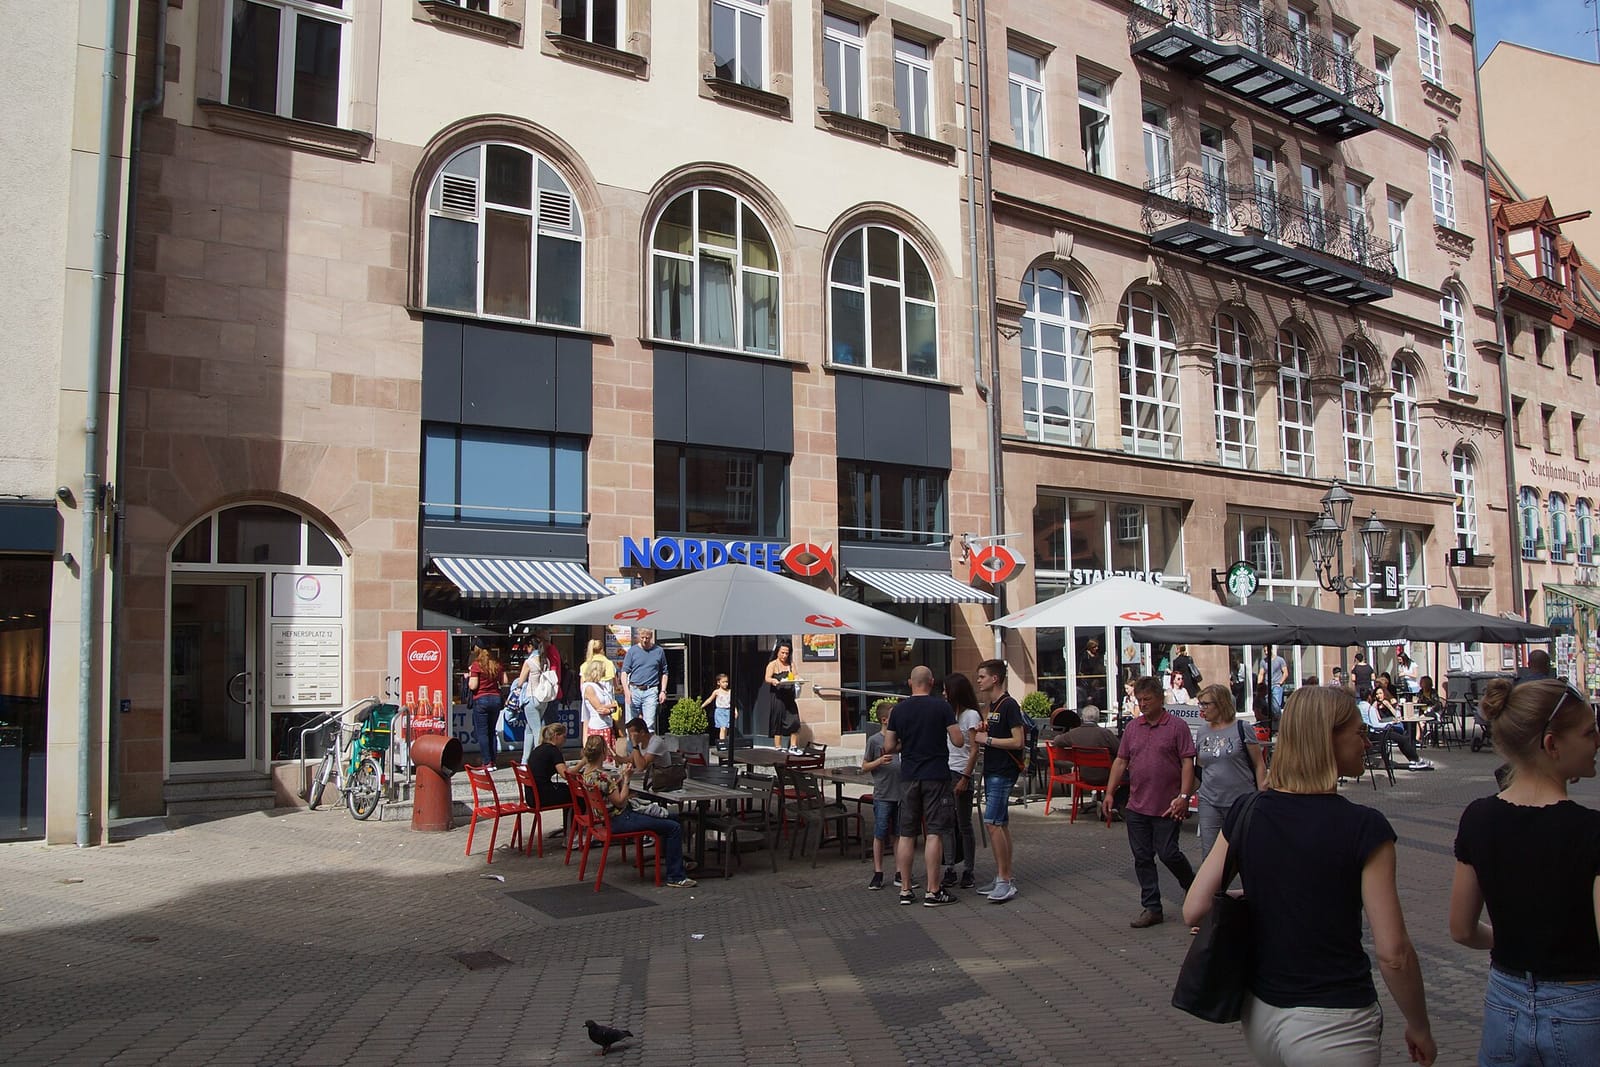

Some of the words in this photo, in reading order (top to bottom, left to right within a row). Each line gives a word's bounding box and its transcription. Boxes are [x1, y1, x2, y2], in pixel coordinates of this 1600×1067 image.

[1529, 457, 1580, 489] Buchhandlung
[620, 536, 781, 573] NORDSEE
[1168, 709, 1199, 718] ORDSEE
